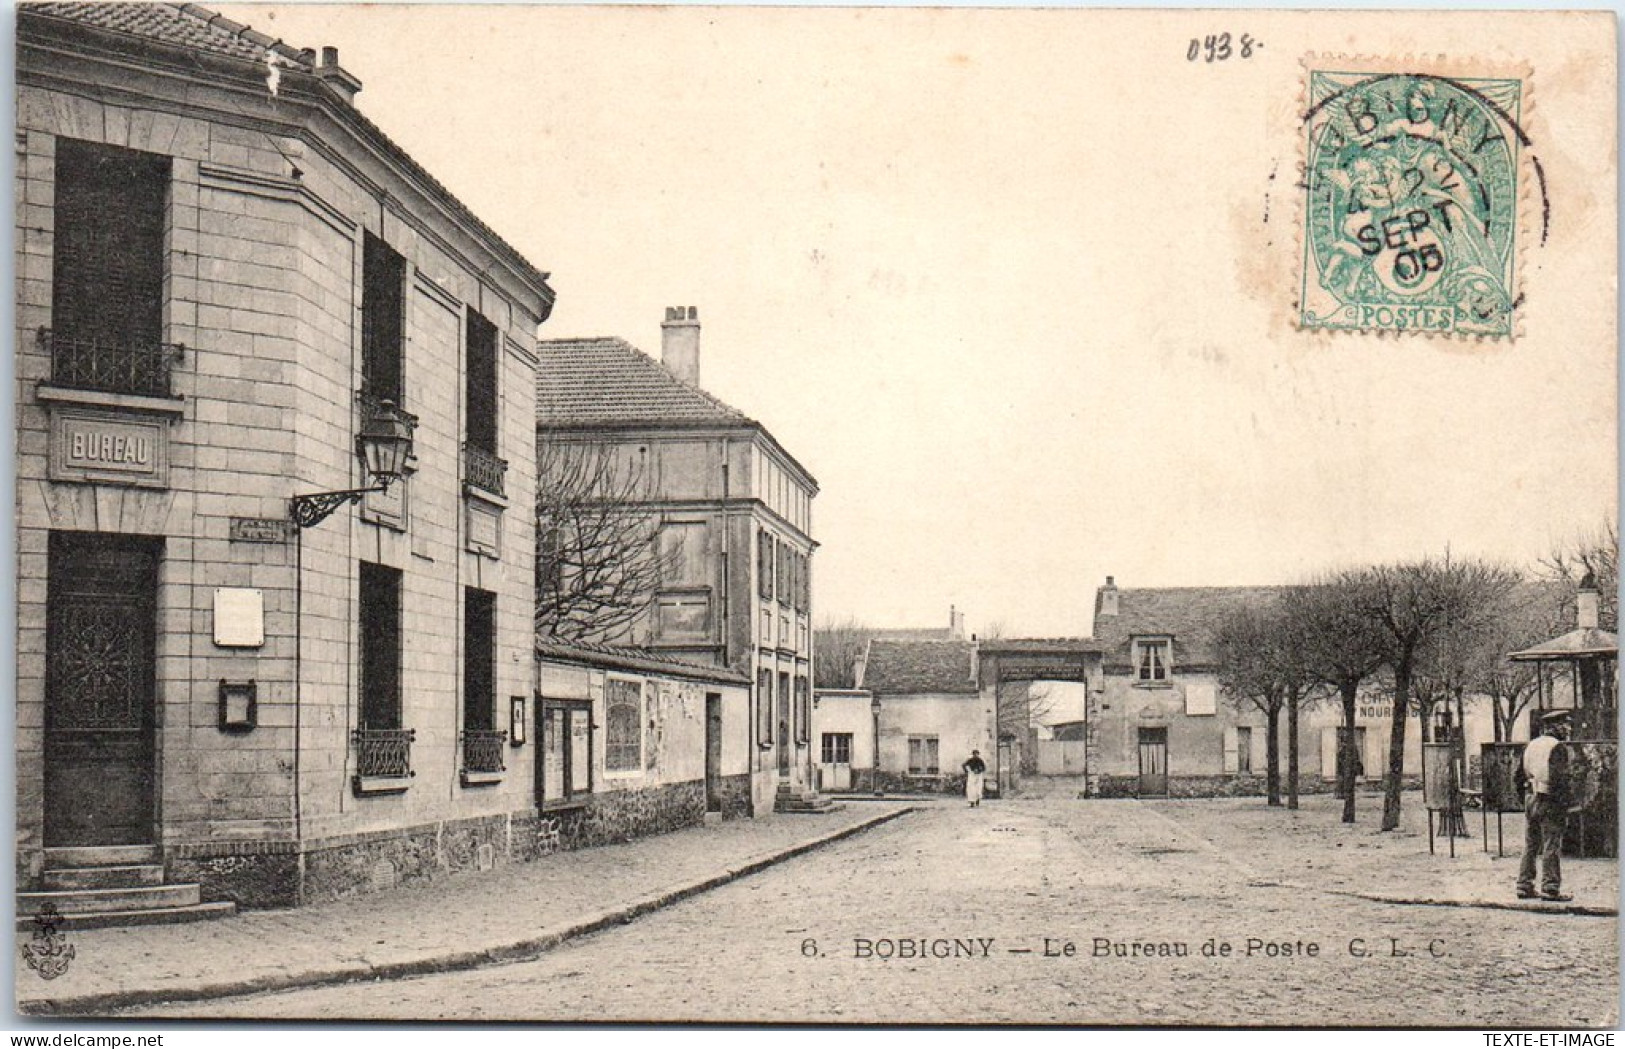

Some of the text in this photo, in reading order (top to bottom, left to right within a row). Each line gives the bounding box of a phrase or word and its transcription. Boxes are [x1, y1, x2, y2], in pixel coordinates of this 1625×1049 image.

[1357, 199, 1453, 255] SEPT
[1360, 306, 1450, 330] POSTES
[72, 432, 148, 465] BUREAU
